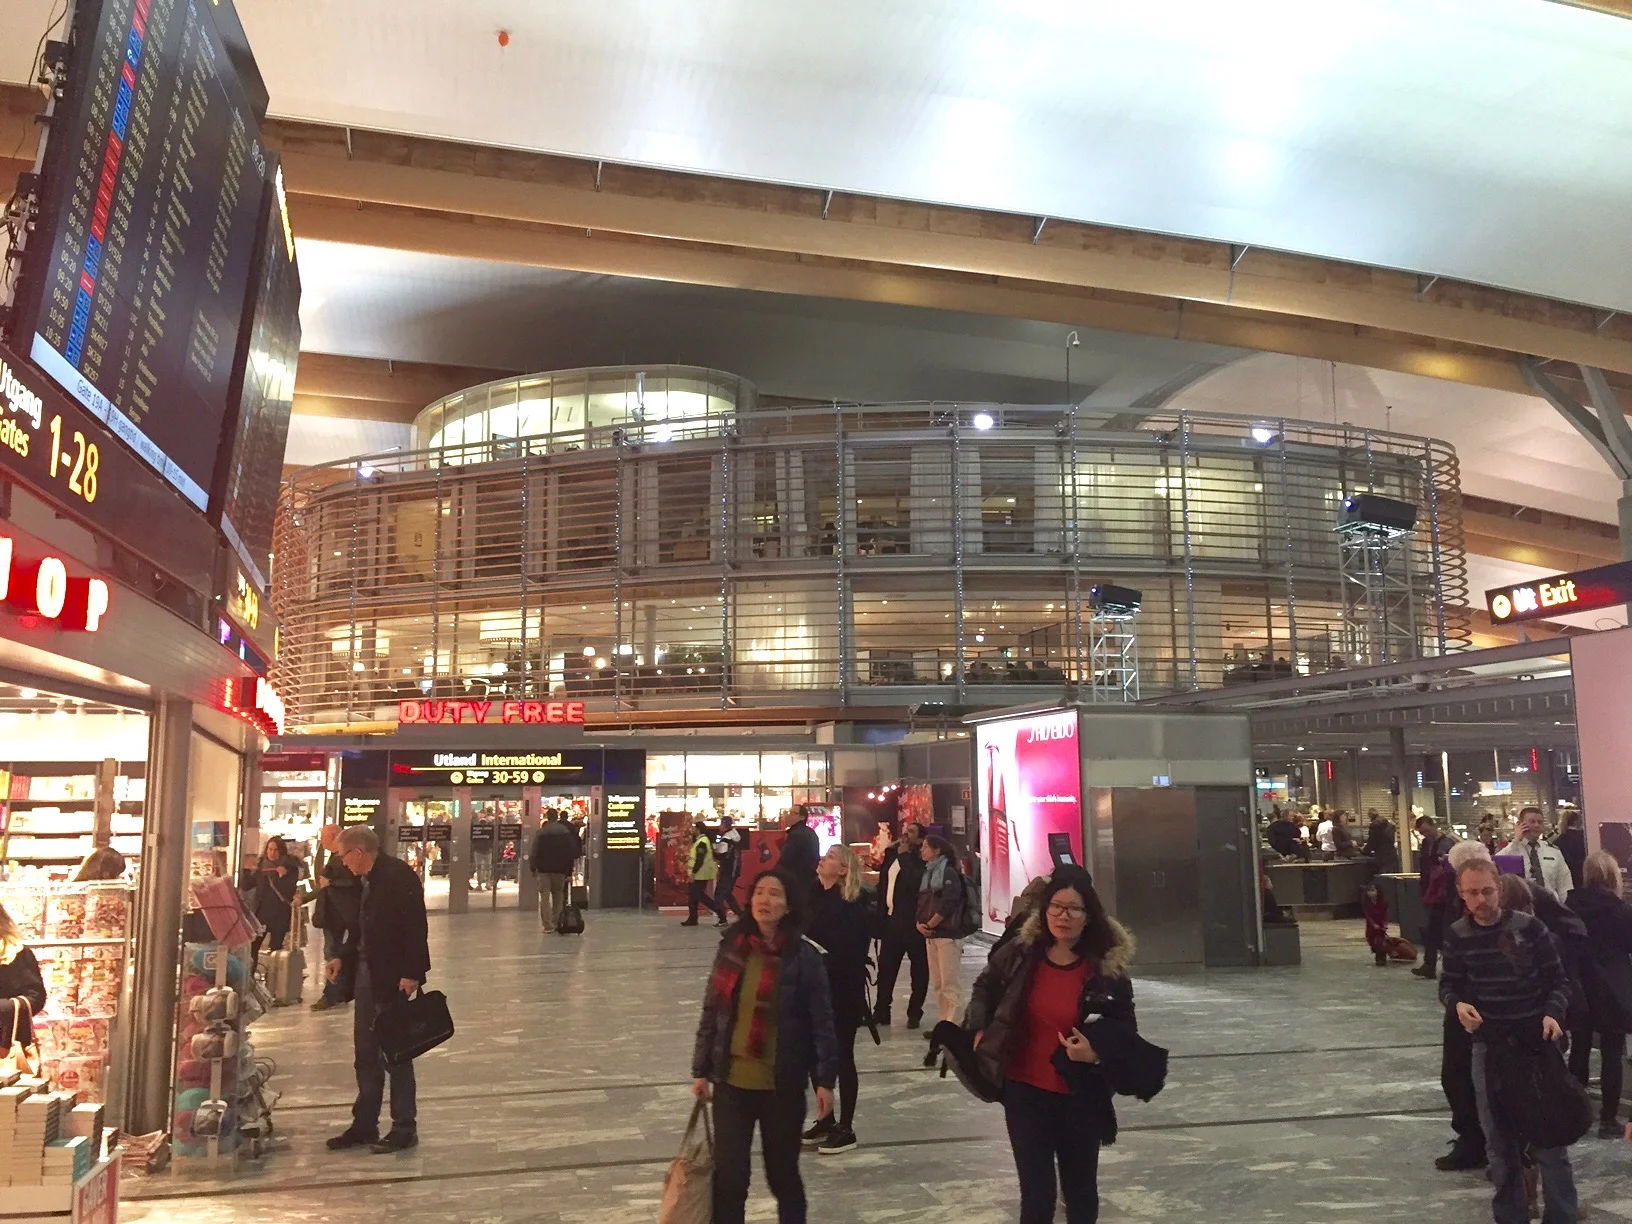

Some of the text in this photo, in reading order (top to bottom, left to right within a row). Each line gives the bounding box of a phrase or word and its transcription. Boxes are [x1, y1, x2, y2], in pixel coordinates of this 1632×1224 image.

[65, 232, 80, 255] 09:10
[61, 250, 76, 273] 09:20
[53, 287, 69, 310] 09:50
[57, 268, 72, 292] 09:20
[94, 311, 109, 333] SK211
[50, 306, 65, 328] 10:05
[46, 326, 61, 347] 10:35
[83, 363, 99, 383] SK257
[77, 379, 92, 402] Gate
[50, 414, 99, 503] 1-28
[1539, 578, 1578, 607] Exit
[398, 700, 587, 724] DUTY FREE
[433, 752, 562, 767] Utland International
[491, 770, 529, 784] 30-59
